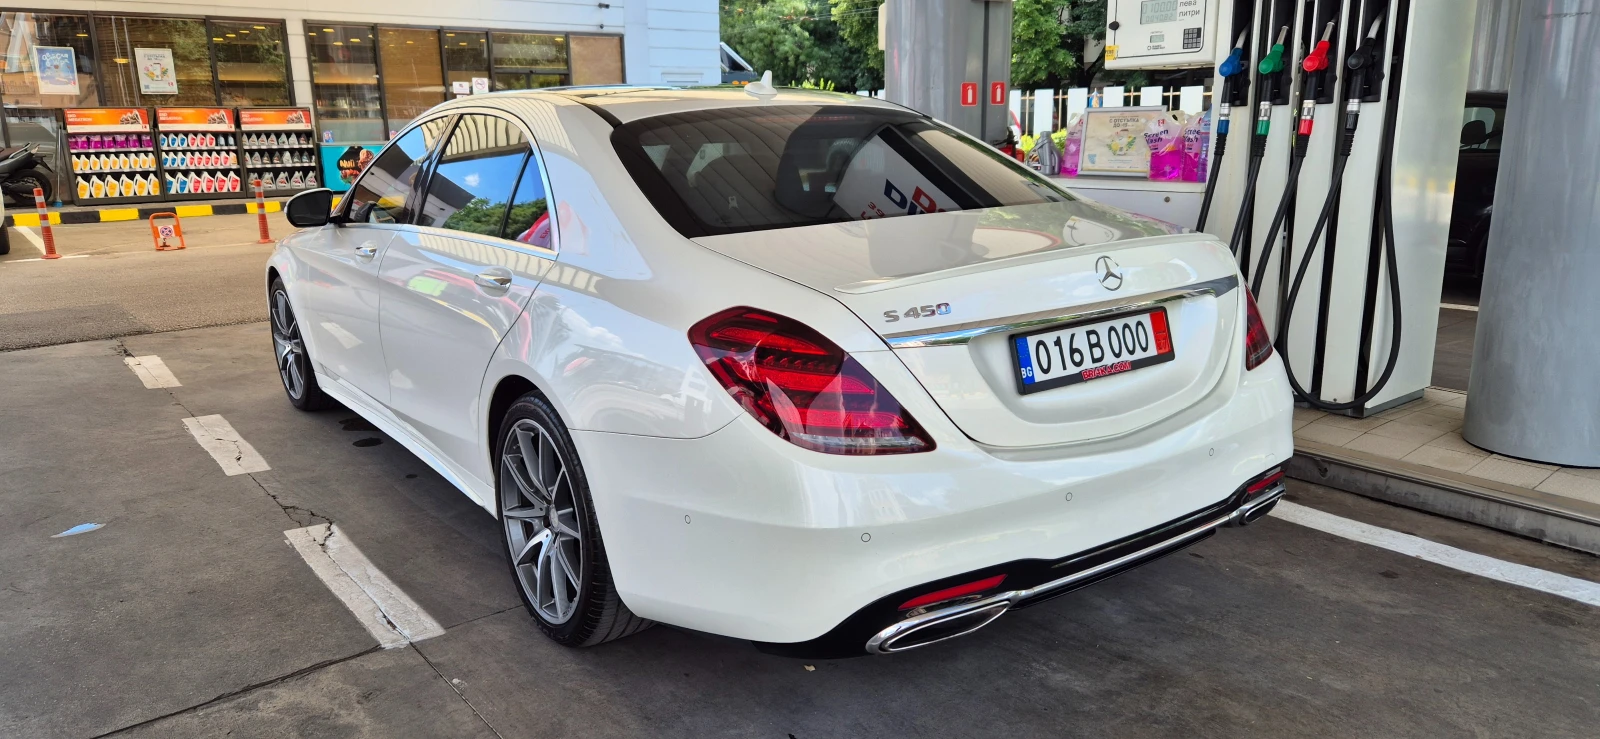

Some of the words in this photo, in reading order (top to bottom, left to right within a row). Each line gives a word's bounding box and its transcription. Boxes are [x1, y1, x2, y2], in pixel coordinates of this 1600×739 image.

[1178, 9, 1200, 17] литри
[1144, 129, 1169, 138] Screen
[883, 309, 900, 323] S
[903, 302, 951, 319] 450
[1035, 332, 1084, 375] 016
[1086, 329, 1105, 363] B
[1108, 320, 1149, 359] 000
[1021, 366, 1032, 379] BG
